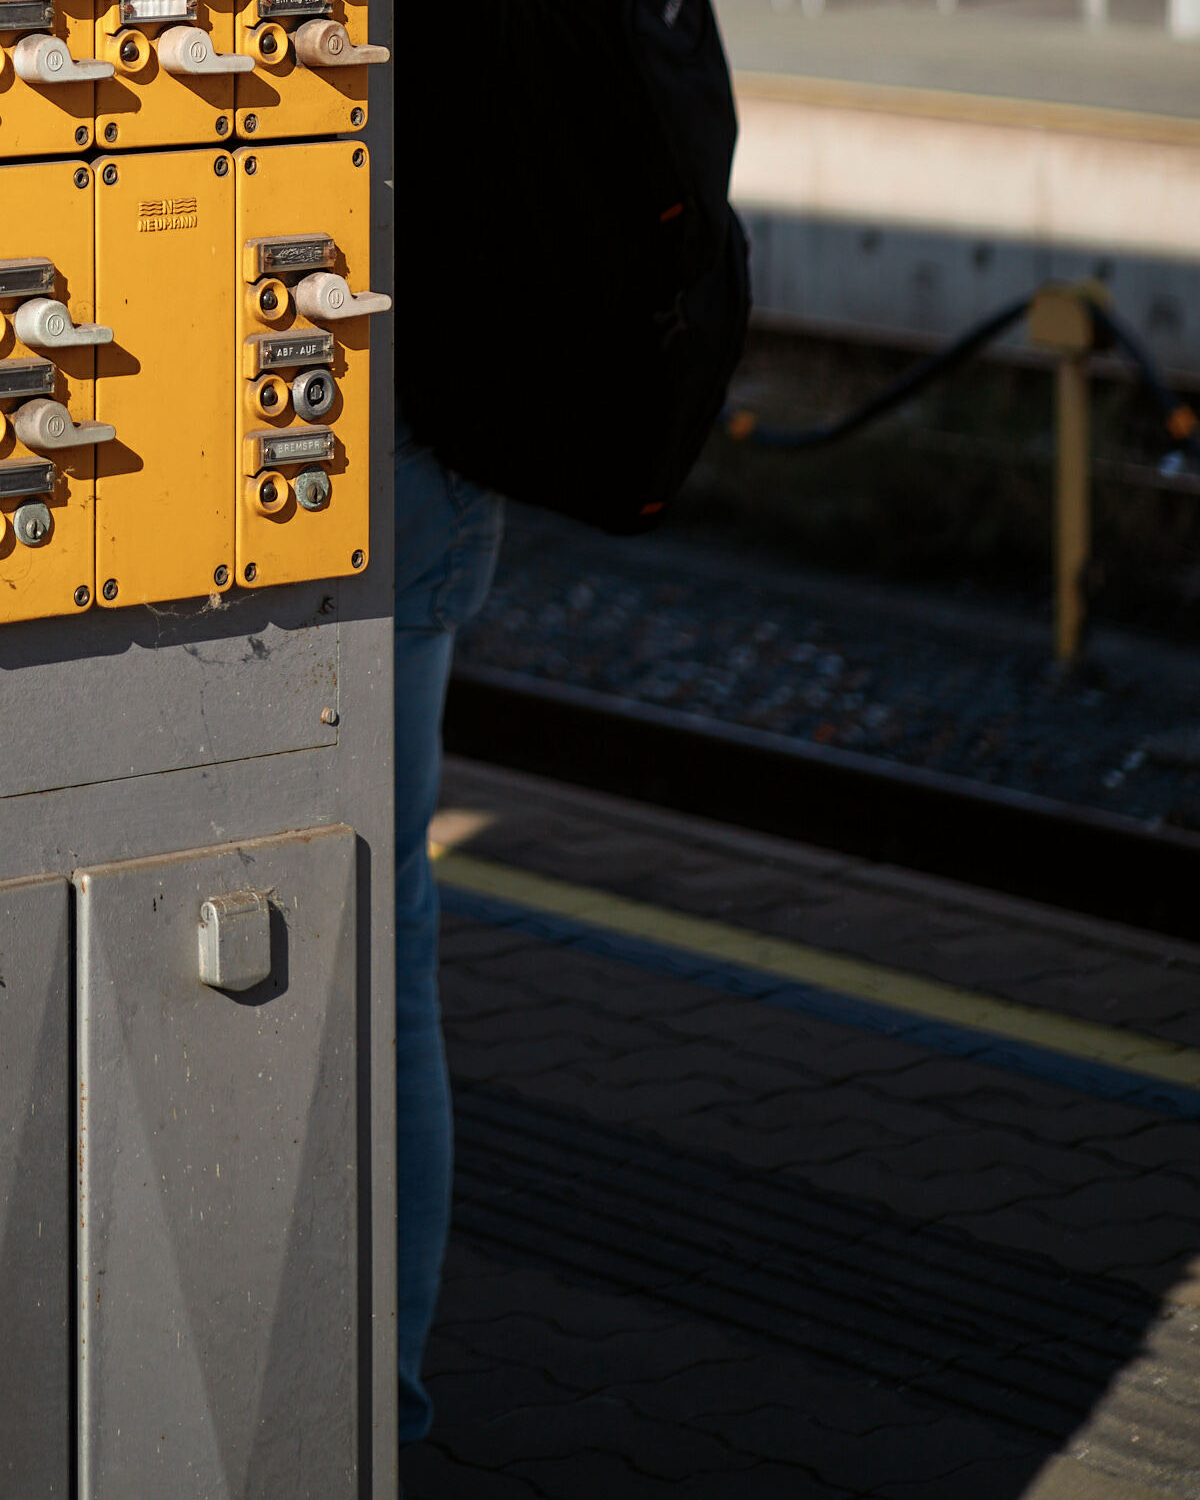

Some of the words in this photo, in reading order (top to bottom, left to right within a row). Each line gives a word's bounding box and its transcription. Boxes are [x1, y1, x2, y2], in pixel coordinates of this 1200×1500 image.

[138, 216, 198, 232] NEUMANN
[276, 347, 294, 357] ABF
[299, 344, 317, 355] AUF
